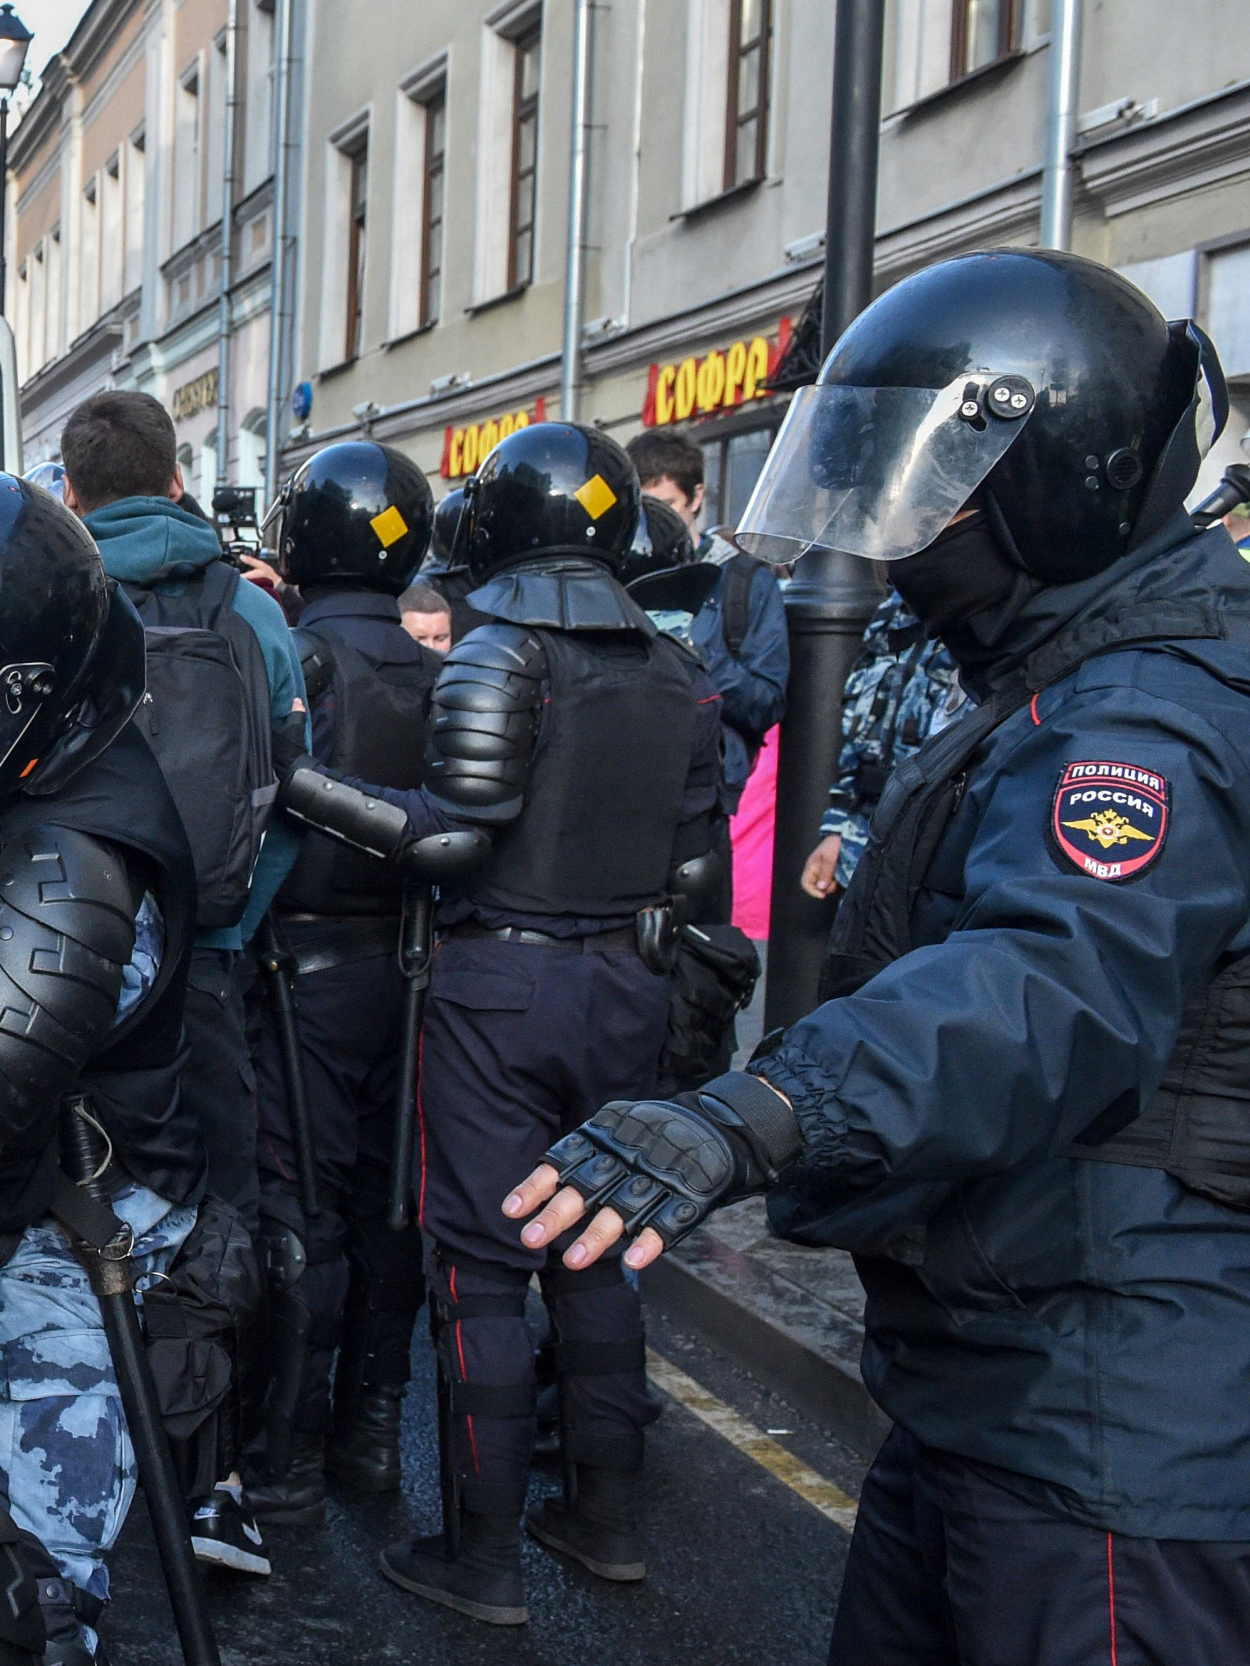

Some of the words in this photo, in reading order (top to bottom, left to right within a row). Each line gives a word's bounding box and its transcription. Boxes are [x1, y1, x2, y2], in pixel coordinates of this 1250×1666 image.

[656, 336, 769, 425] СОФРА
[1071, 765, 1160, 791] ПОЛИЦИЯ
[1070, 790, 1154, 818] РОССИЯ
[1084, 857, 1122, 878] МВД
